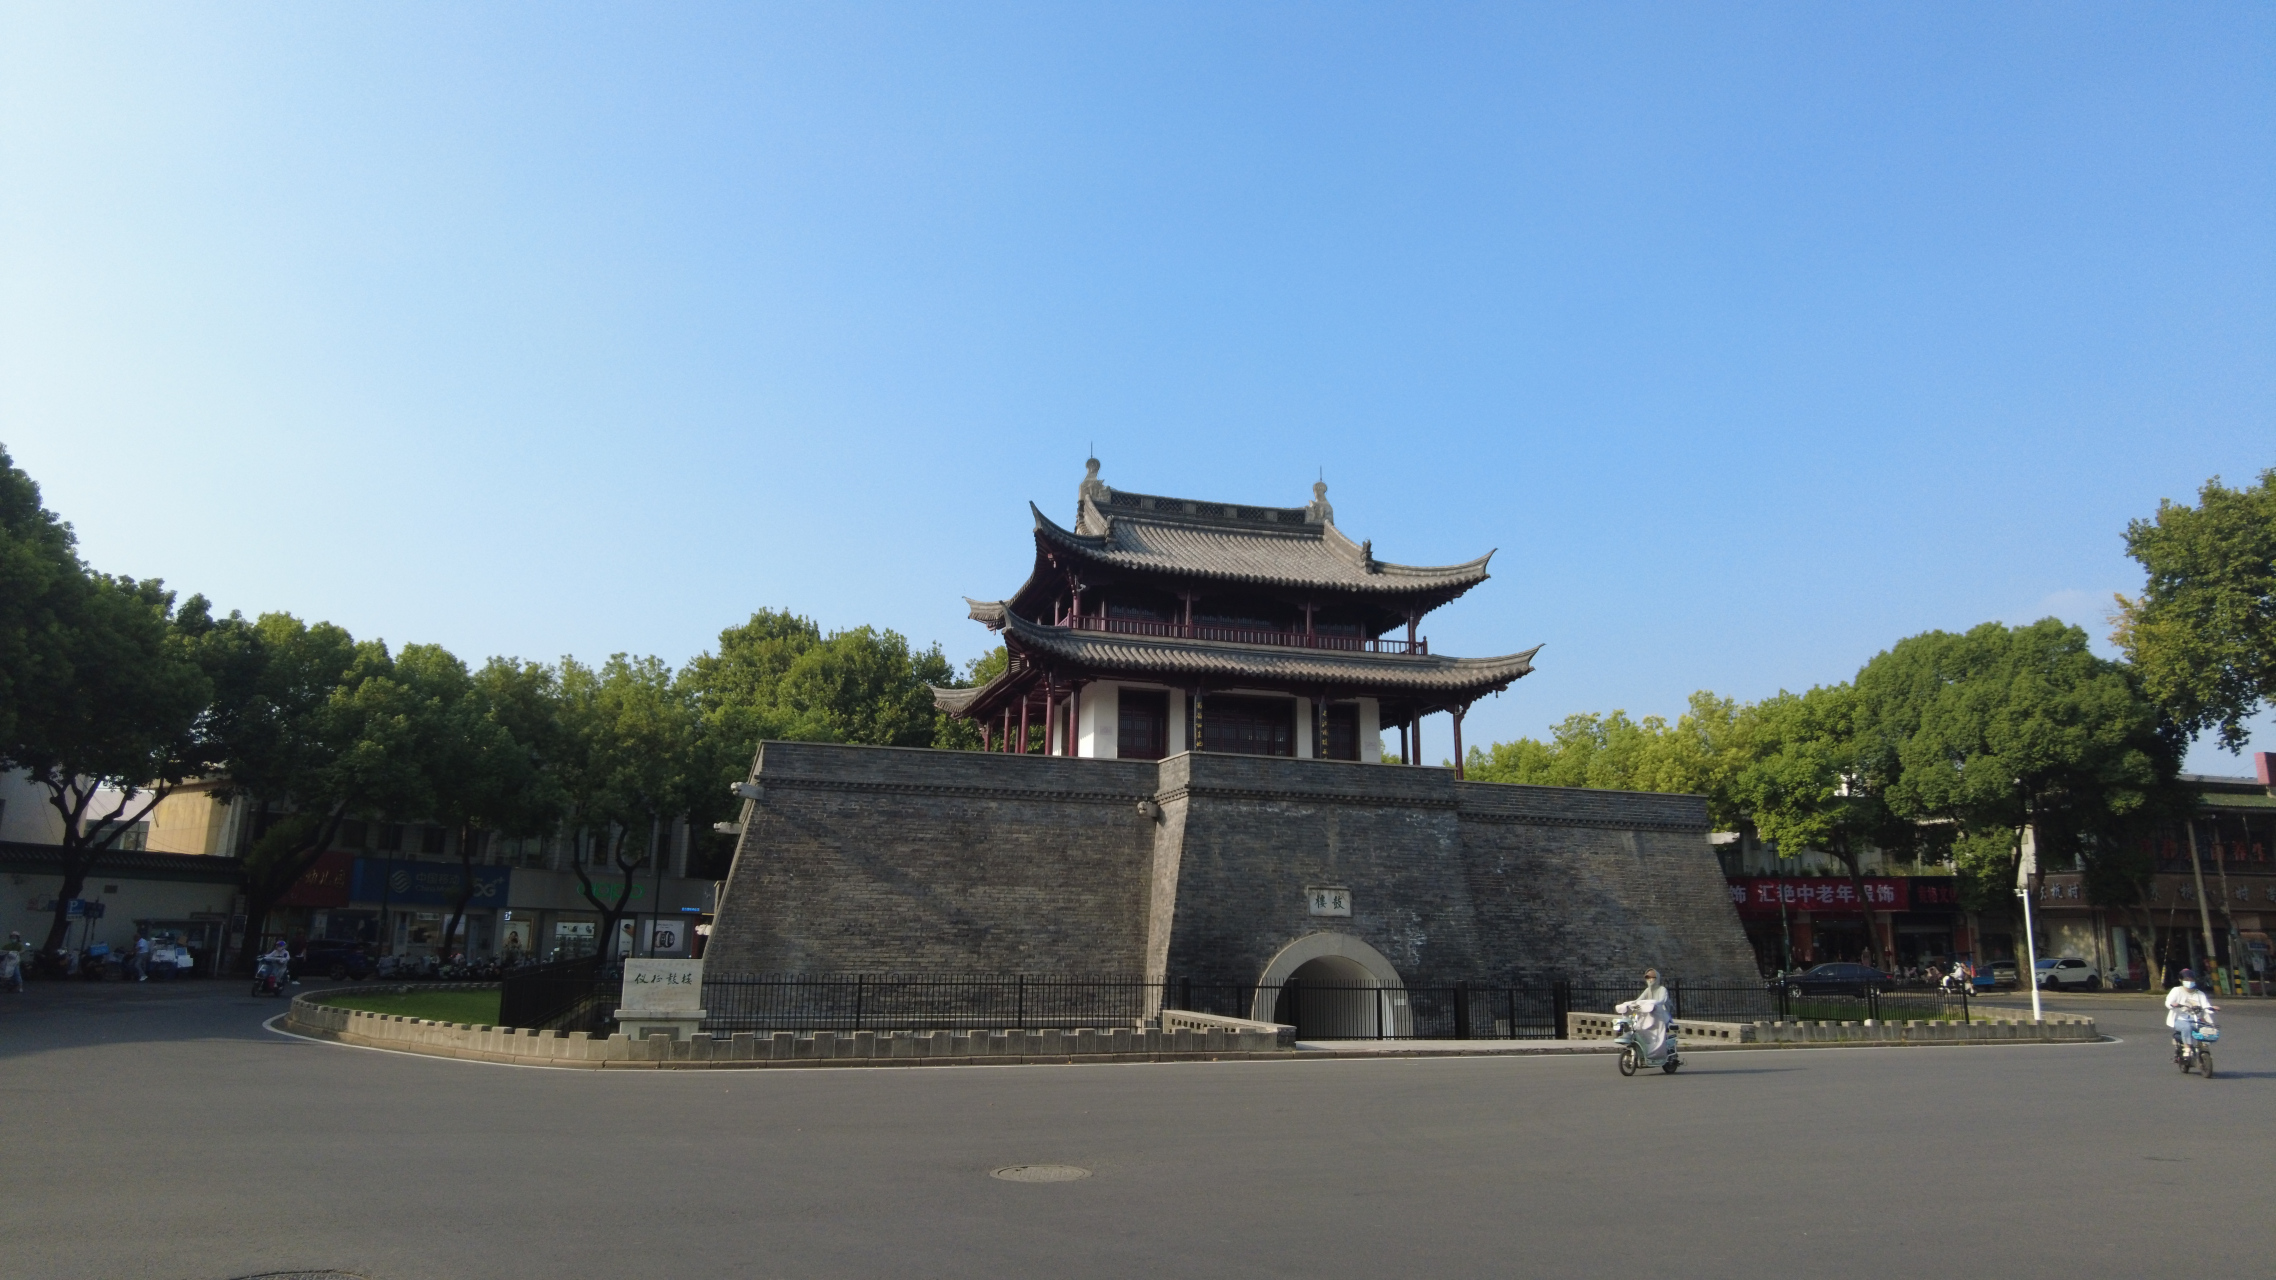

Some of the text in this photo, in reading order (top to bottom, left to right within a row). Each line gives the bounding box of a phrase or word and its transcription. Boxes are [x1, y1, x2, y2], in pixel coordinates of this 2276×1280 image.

[415, 871, 461, 885] 中国移动
[1757, 883, 1895, 904] 汇艳中老年服饰
[68, 899, 79, 913] P
